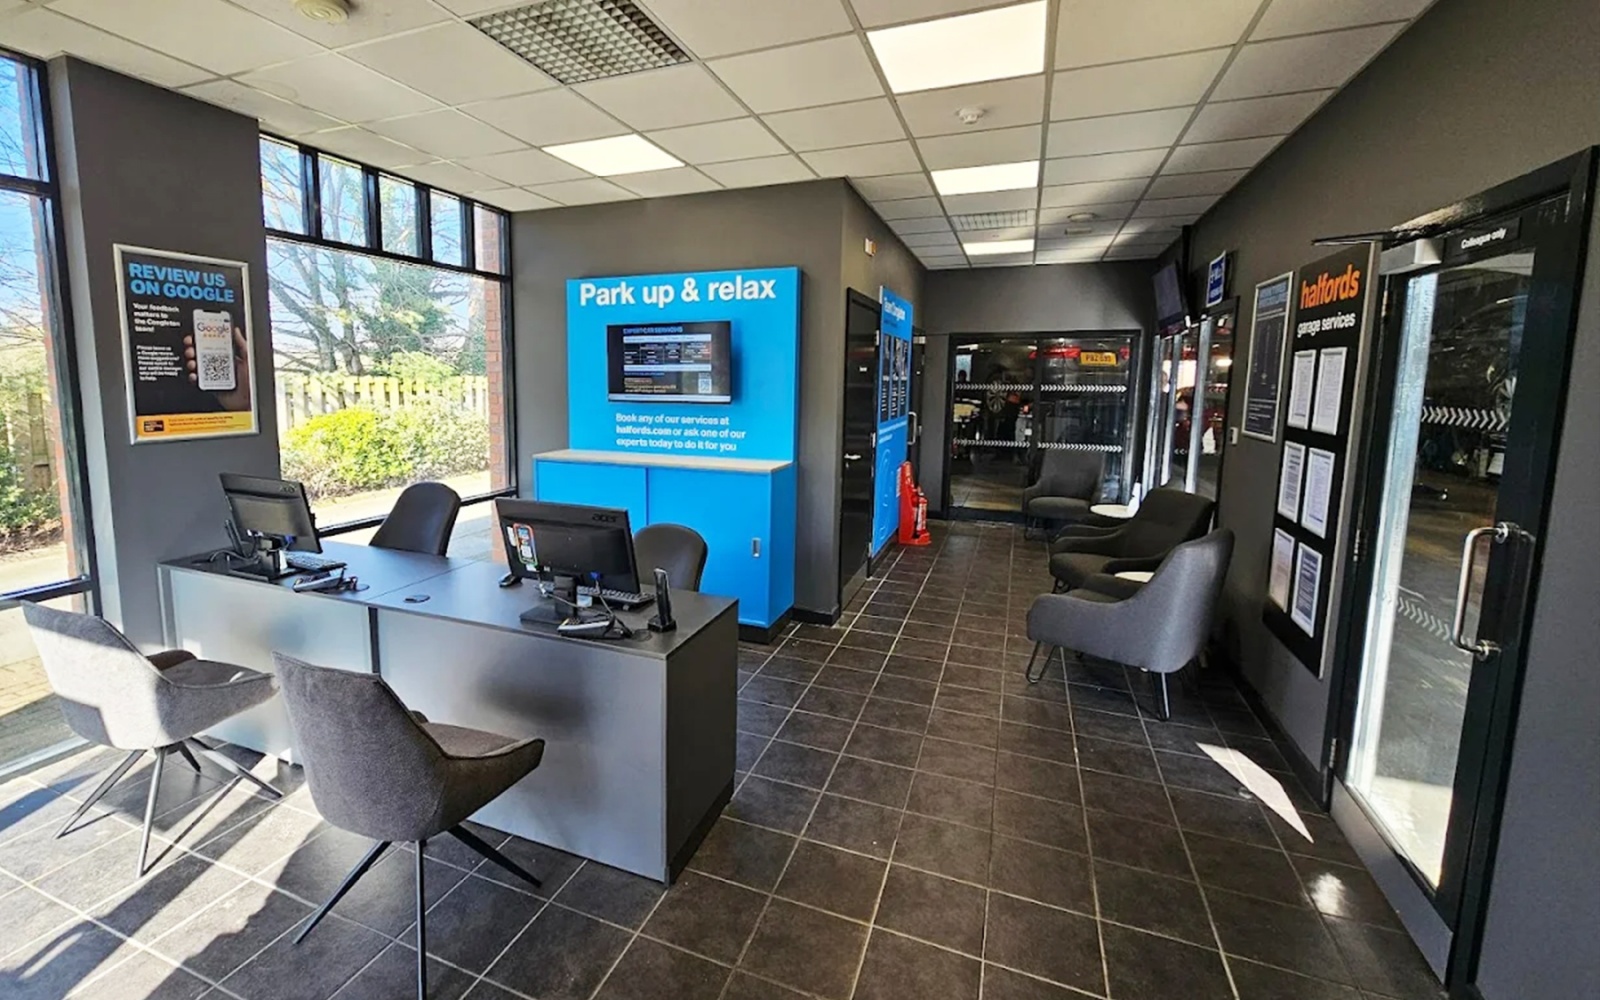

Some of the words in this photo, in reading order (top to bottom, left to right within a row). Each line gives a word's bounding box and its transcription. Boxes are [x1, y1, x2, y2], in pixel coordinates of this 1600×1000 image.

[1461, 234, 1491, 249] Colleague
[1491, 228, 1507, 240] only
[128, 263, 200, 285] REVIEW
[202, 272, 226, 288] US
[130, 280, 160, 296] ON
[163, 282, 235, 303] GOOGLE
[580, 281, 636, 307] Park
[642, 283, 675, 309] up
[680, 277, 700, 303] &
[708, 275, 776, 301] relax
[1300, 264, 1361, 310] halfords
[133, 302, 148, 310] Your
[149, 303, 180, 312] feedback
[147, 318, 181, 327] Congleton
[1297, 320, 1320, 338] garage
[1321, 312, 1356, 331] services
[615, 413, 637, 423] Book
[638, 415, 654, 424] any
[654, 413, 664, 423] of
[665, 416, 679, 424] our
[681, 415, 718, 425] services
[719, 416, 730, 426] at
[615, 425, 671, 435] halfords.com
[673, 427, 682, 435] or
[683, 426, 699, 436] ask
[700, 429, 717, 438] one
[719, 428, 729, 438] of
[730, 430, 746, 439] our
[615, 438, 648, 448] experts
[649, 438, 673, 450] today
[674, 439, 683, 449] to
[684, 439, 696, 449] do
[697, 440, 704, 449] it
[705, 440, 719, 450] for
[719, 443, 737, 453] you
[592, 513, 619, 522] acer
